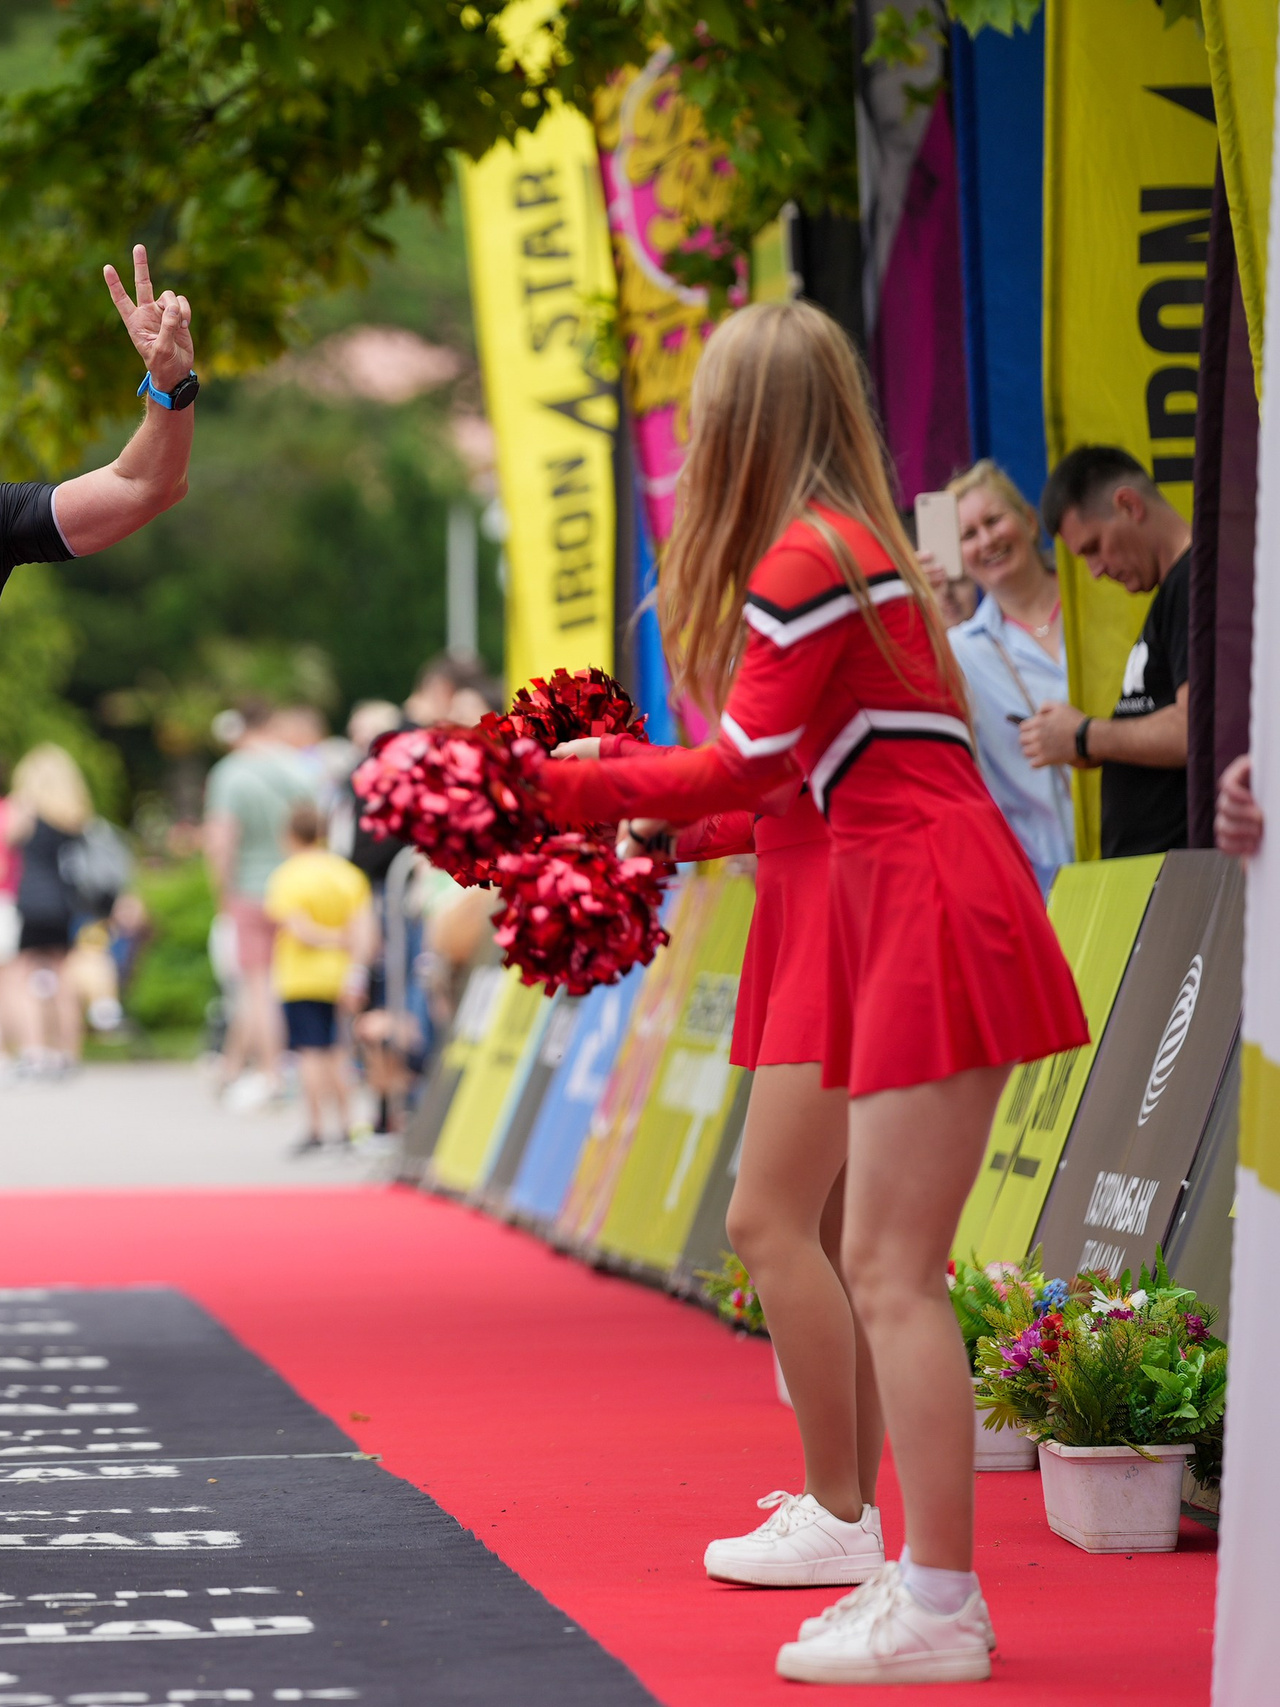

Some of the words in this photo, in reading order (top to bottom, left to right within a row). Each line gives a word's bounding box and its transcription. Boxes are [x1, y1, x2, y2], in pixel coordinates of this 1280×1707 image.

[515, 166, 580, 356] STAR
[1138, 187, 1214, 484] IRON
[545, 456, 596, 632] IRON
